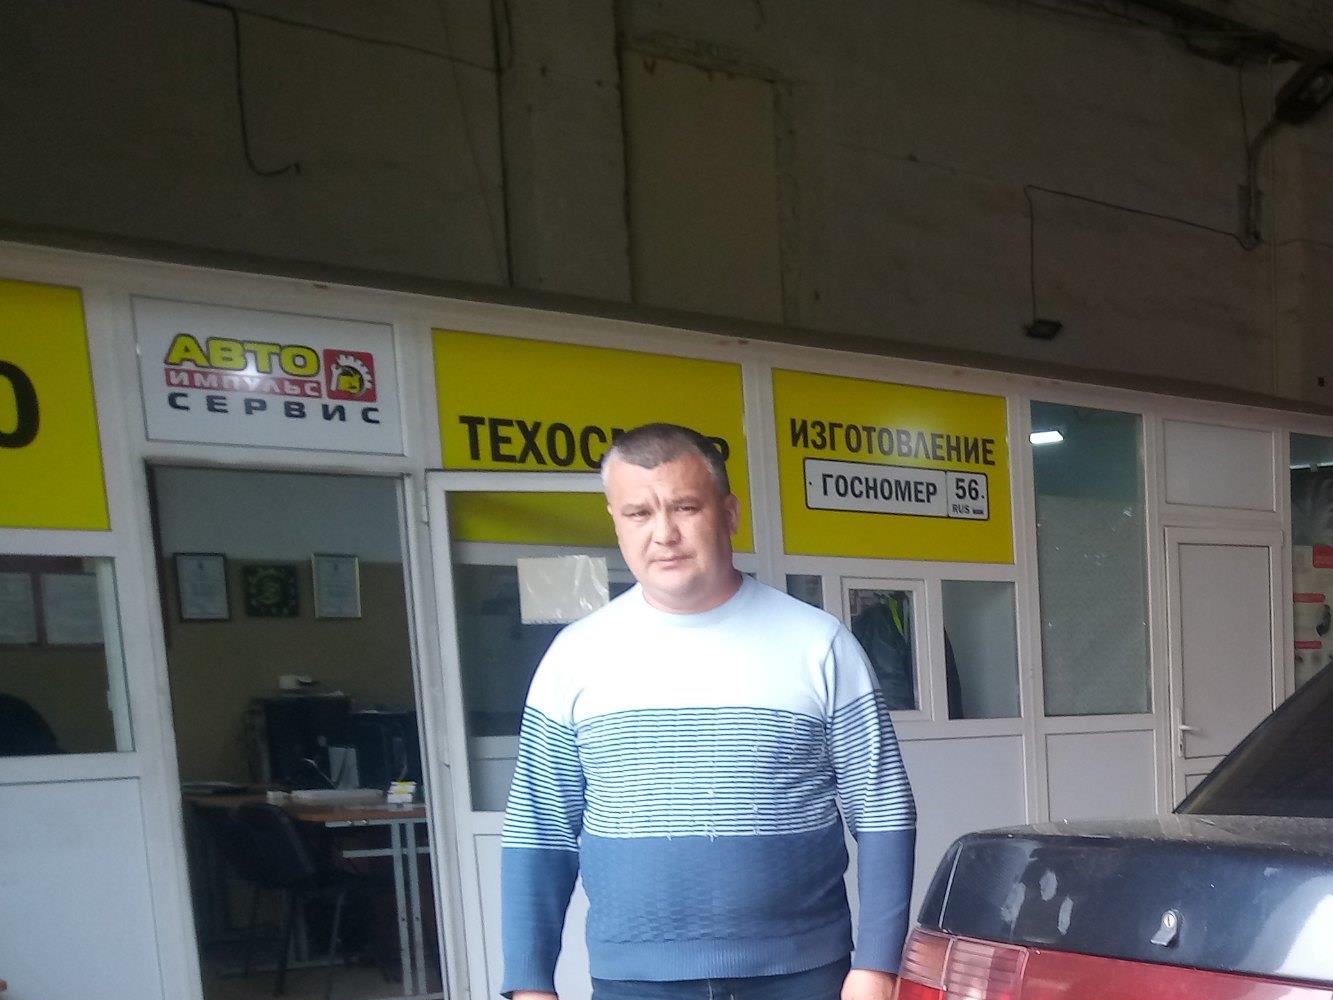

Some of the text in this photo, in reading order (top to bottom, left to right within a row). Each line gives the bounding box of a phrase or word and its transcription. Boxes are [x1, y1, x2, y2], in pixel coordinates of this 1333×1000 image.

[164, 333, 321, 378] АВТО
[168, 368, 321, 398] ИМПУЛЬС
[167, 391, 381, 425] СЕРВИС
[789, 418, 996, 466] ИЗГОТОВЛЕНИЕ
[821, 473, 980, 504] ГОСНОМЕР 56
[952, 503, 971, 515] RUS
